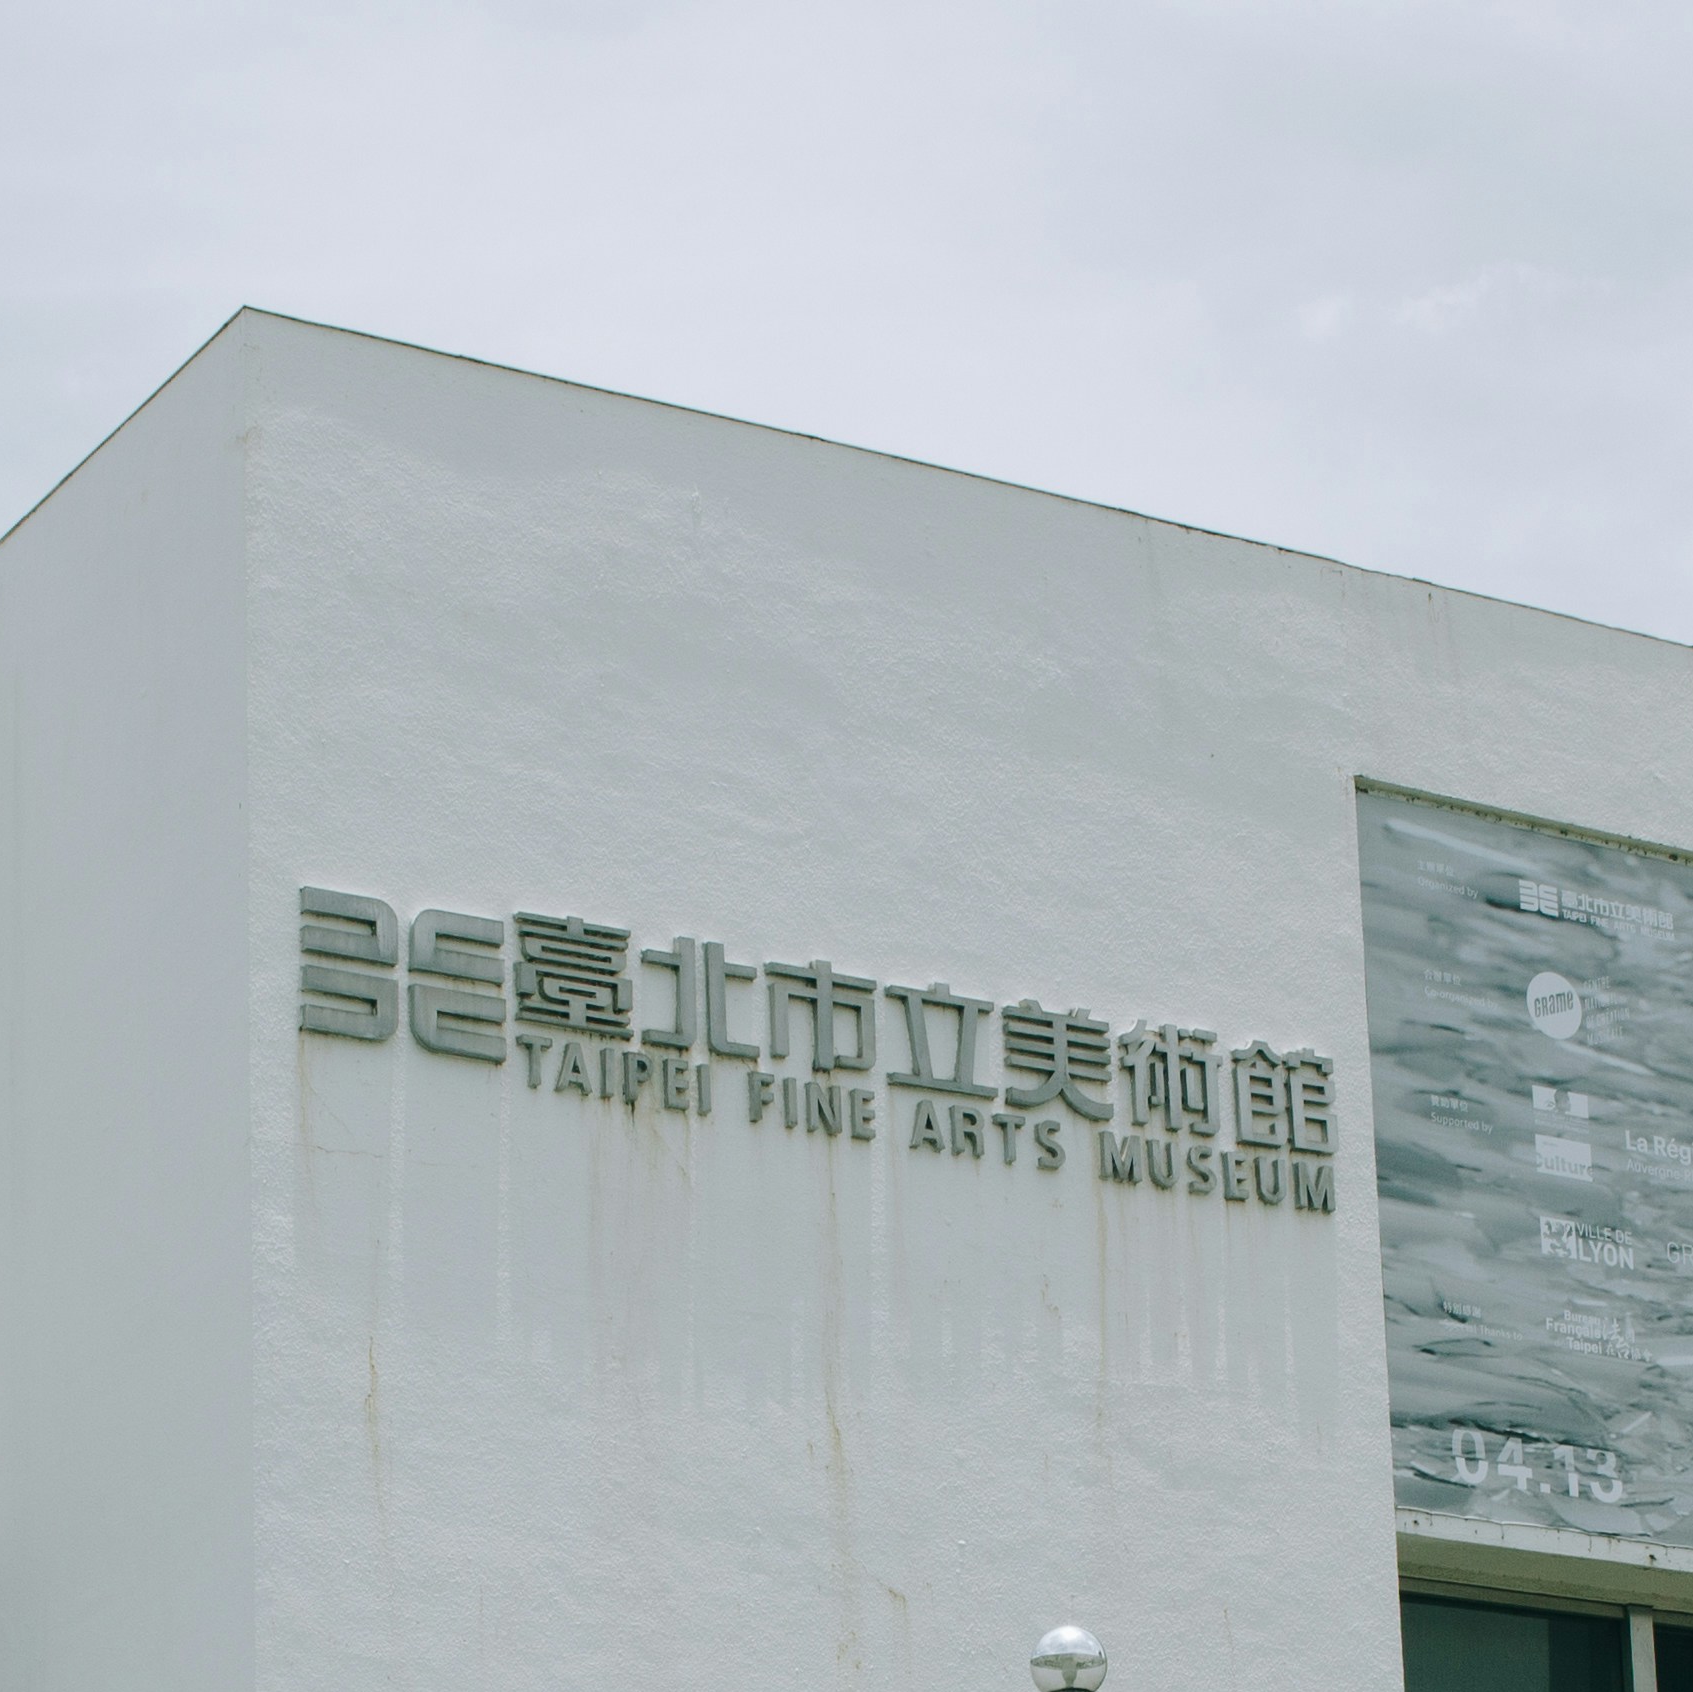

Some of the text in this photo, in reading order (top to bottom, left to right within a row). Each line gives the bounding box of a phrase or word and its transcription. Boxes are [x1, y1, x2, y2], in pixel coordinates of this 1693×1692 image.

[1417, 876, 1479, 900] Organized by
[1562, 908, 1676, 943] TAIPEI FINE ARTS MUSEUM
[1424, 985, 1485, 1008] Co-organized
[513, 911, 1339, 1156] 臺北市立美術館
[518, 1032, 1336, 1214] TAIPEI FINE ARTS MUSEUM
[1430, 1111, 1493, 1136] Supported by
[1624, 1130, 1647, 1154] La
[1576, 1222, 1633, 1246] VILLE DE
[1578, 1238, 1635, 1271] LYON
[1545, 1316, 1601, 1339] Français
[1563, 1309, 1601, 1326] Bureau
[1565, 1336, 1602, 1355] Taipei
[1451, 1428, 1624, 1504] 04.13
